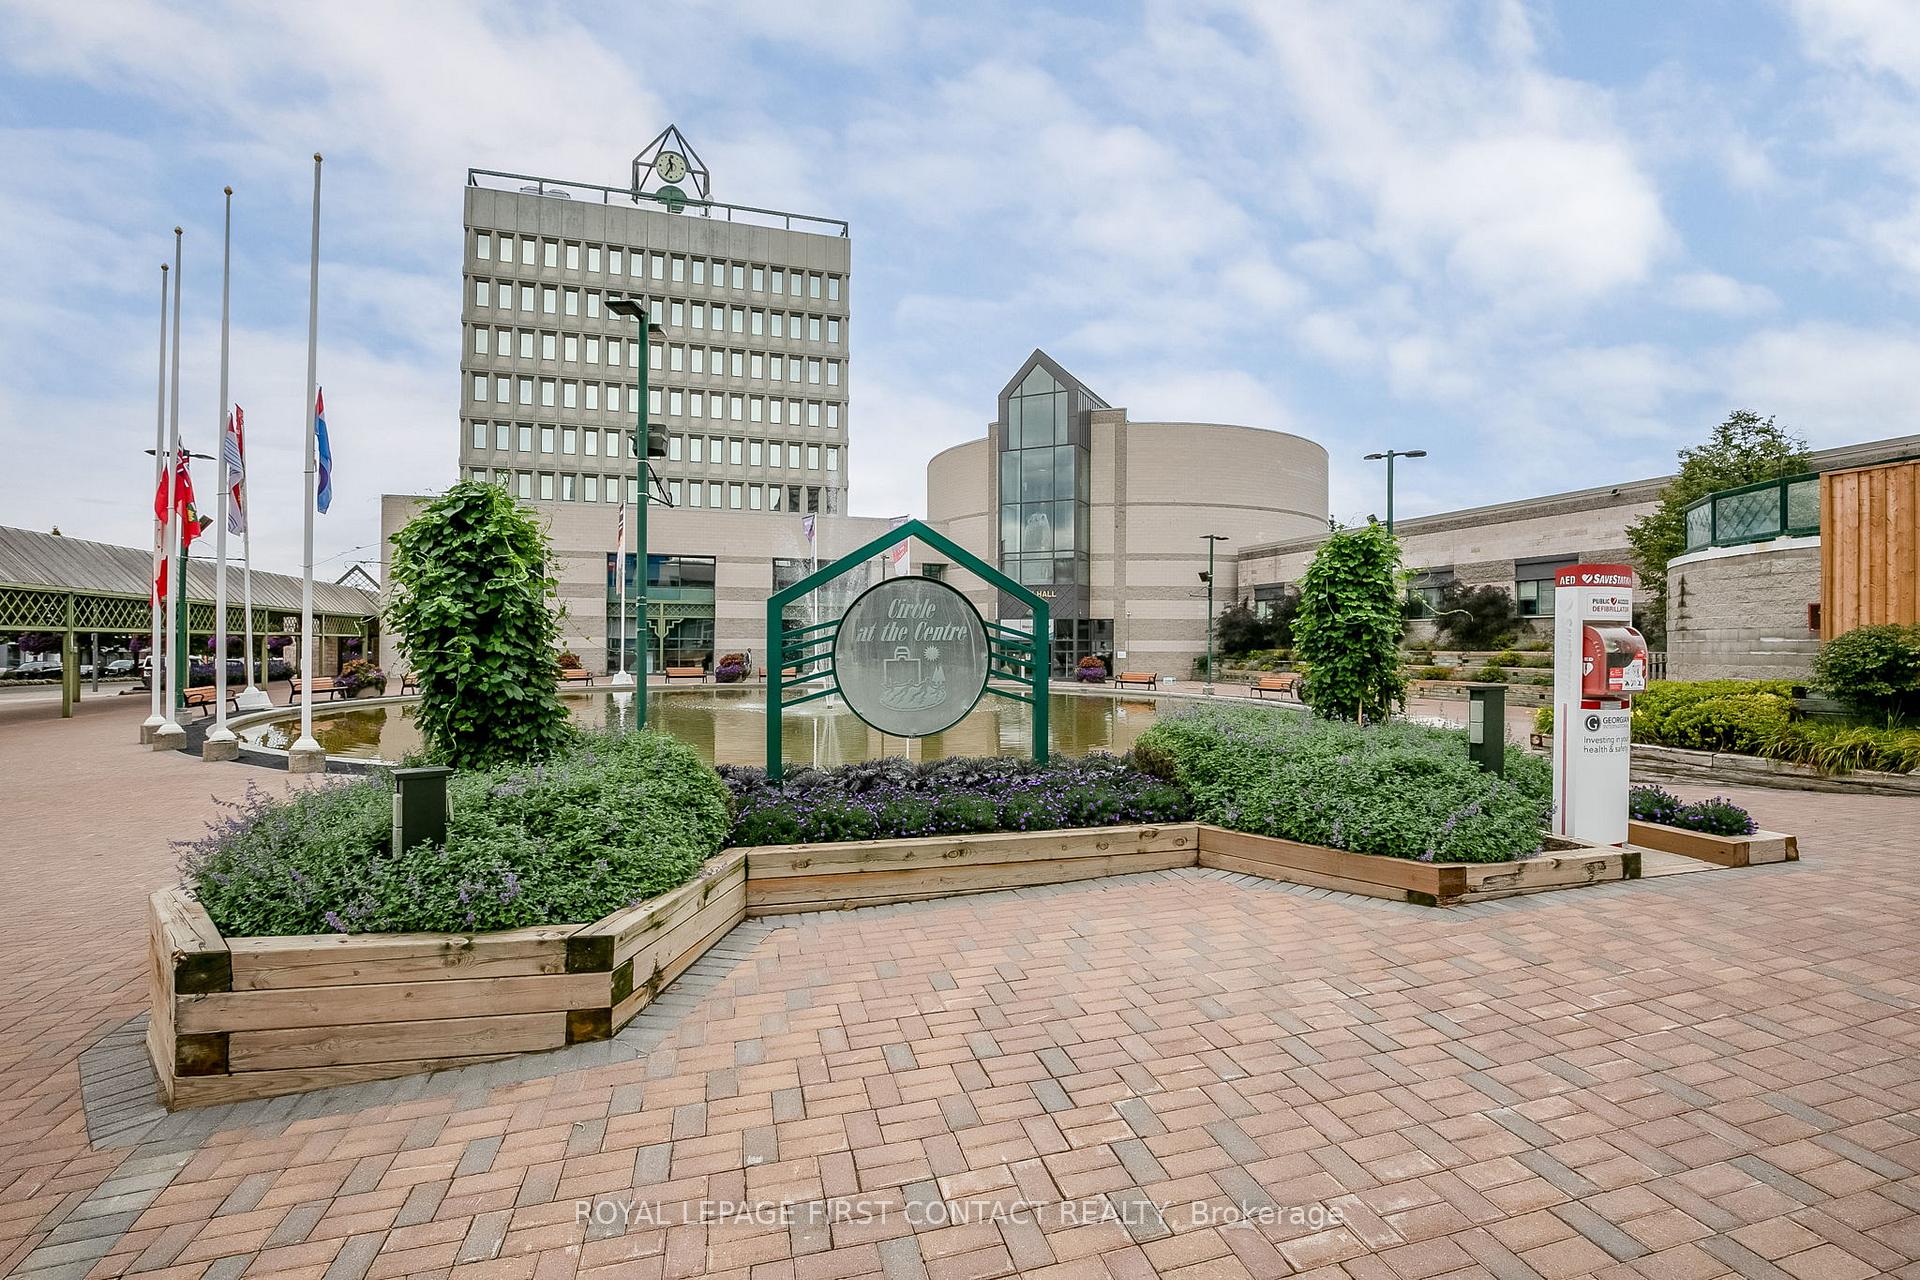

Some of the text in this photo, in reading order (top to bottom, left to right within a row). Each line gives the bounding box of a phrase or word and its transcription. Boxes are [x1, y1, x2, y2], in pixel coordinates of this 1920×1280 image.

[1560, 575, 1576, 584] AED
[1036, 590, 1057, 598] HALL
[888, 598, 936, 619] Circle
[858, 621, 968, 642] at the Centre
[1583, 736, 1615, 746] Investing
[1583, 745, 1608, 753] health
